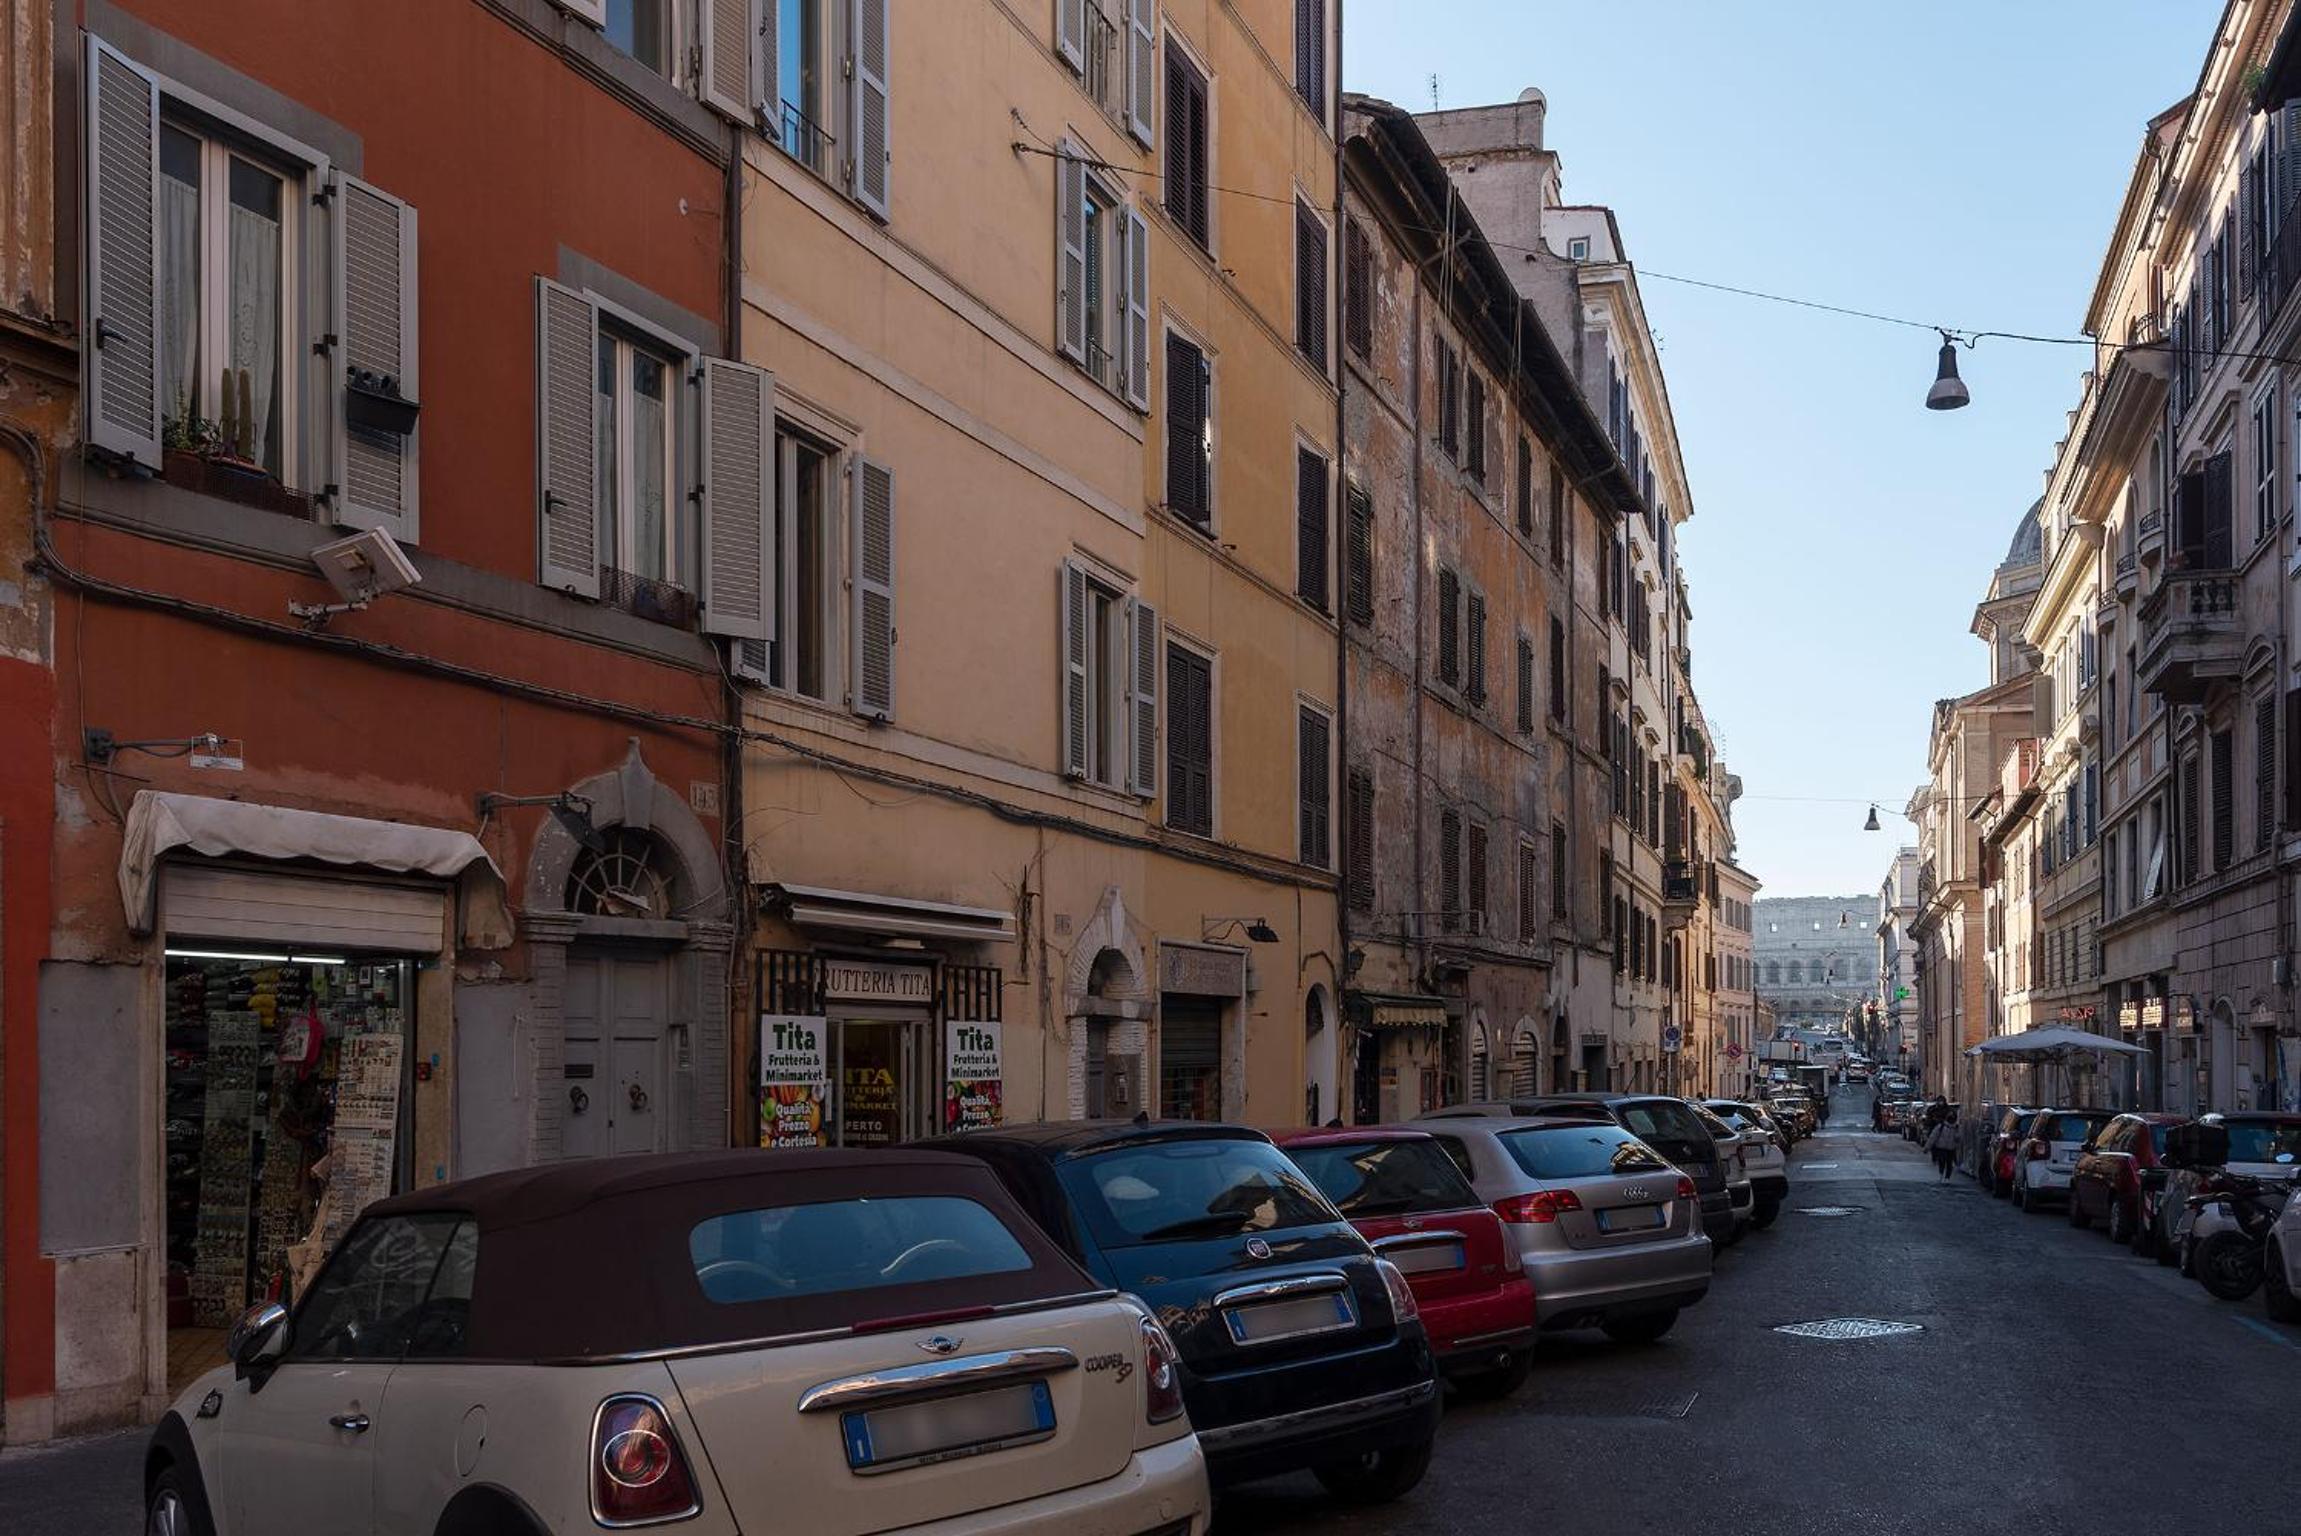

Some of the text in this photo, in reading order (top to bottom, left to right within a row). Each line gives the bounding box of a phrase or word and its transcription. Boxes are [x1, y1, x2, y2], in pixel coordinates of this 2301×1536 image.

[901, 974, 930, 995] TITA
[773, 1022, 817, 1050] Tita
[957, 1027, 995, 1051] Tita
[768, 1053, 812, 1066] Frutteria
[953, 1053, 990, 1065] Frutteria
[766, 1069, 823, 1081] Minimarket
[951, 1067, 1000, 1078] Minimarket
[775, 1102, 812, 1118] Qualità
[778, 1120, 810, 1132] Prezzo
[1084, 1353, 1124, 1372] COOPER
